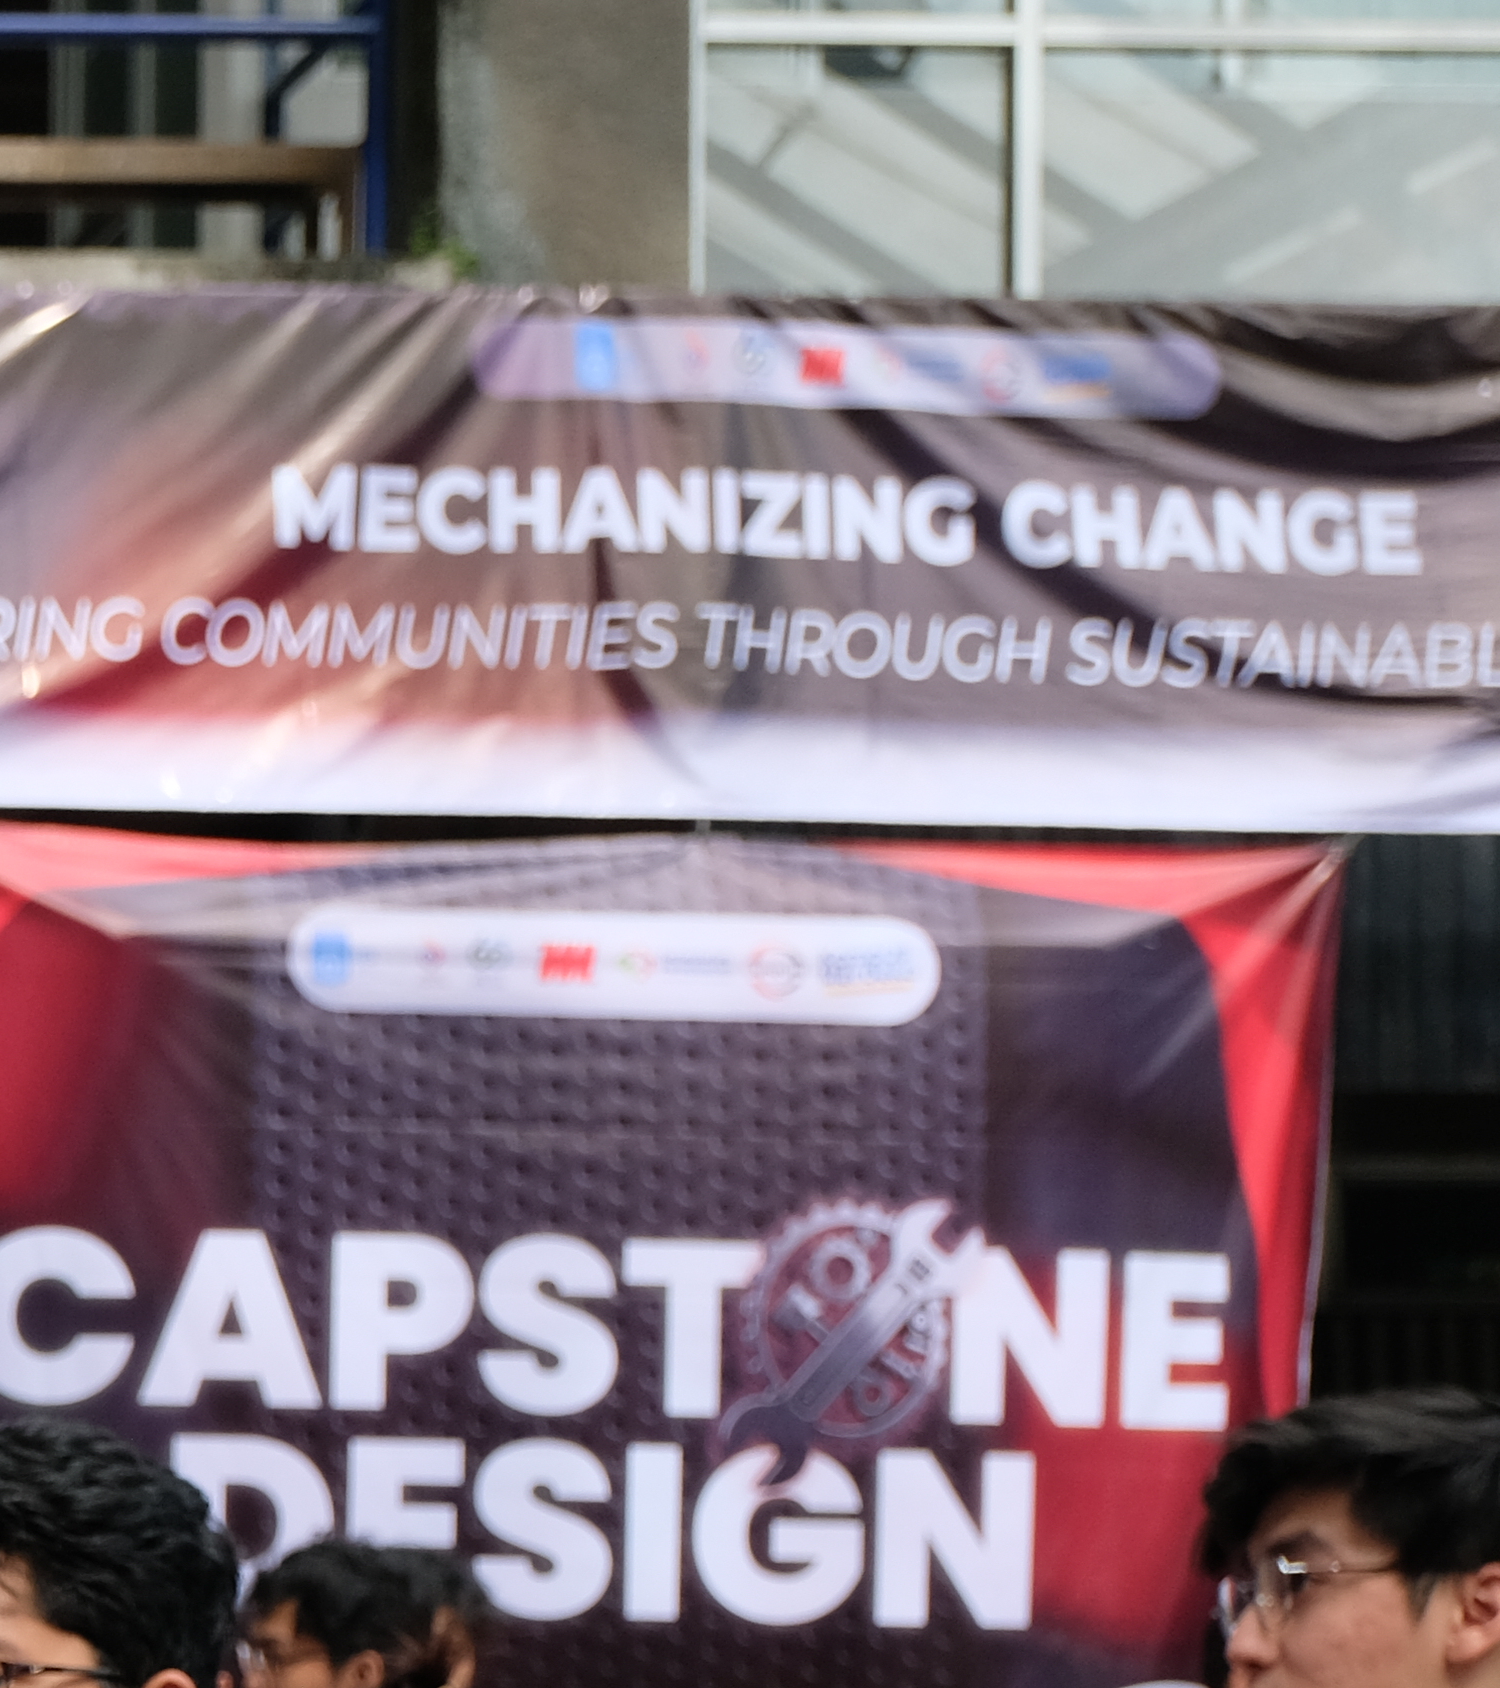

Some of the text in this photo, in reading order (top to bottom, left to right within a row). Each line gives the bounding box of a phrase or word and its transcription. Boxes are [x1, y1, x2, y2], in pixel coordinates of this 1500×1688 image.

[270, 463, 1425, 577] MECHANIZING CHANGE
[159, 594, 682, 673] COMMUNITIES
[696, 601, 1053, 684] THROUGH
